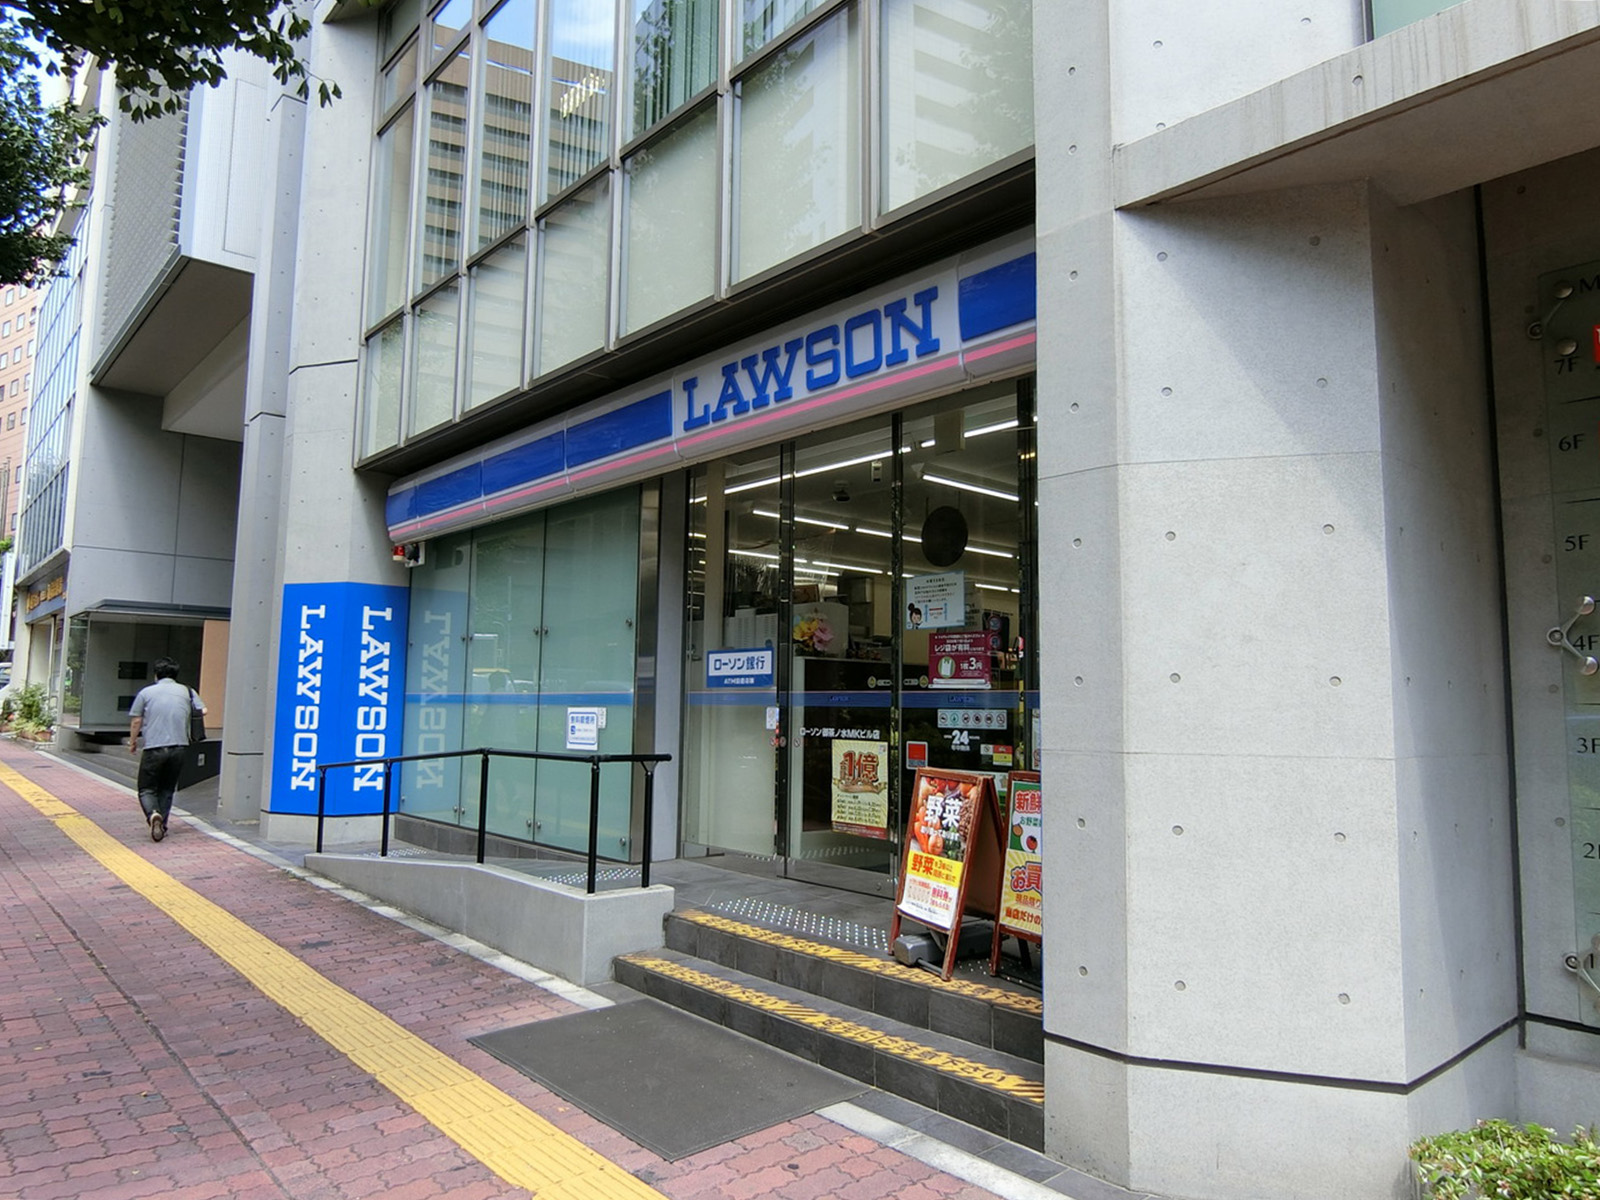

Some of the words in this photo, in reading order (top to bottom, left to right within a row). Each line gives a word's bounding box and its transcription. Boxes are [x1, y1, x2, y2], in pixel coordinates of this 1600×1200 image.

[683, 286, 940, 431] LAWSON
[1554, 355, 1581, 375] 7F
[1558, 433, 1585, 451] 6F
[1564, 534, 1590, 552] 5F
[1572, 635, 1600, 651] 4F
[714, 656, 765, 671] ローソン銀行
[291, 604, 326, 792] LAWSON
[353, 605, 392, 792] LAWSON
[951, 729, 969, 745] 24
[1577, 737, 1600, 753] 3F
[924, 795, 963, 828] 野菜
[1014, 790, 1041, 814] 新鮮
[1019, 815, 1042, 828] お野菜
[911, 854, 934, 875] 野菜
